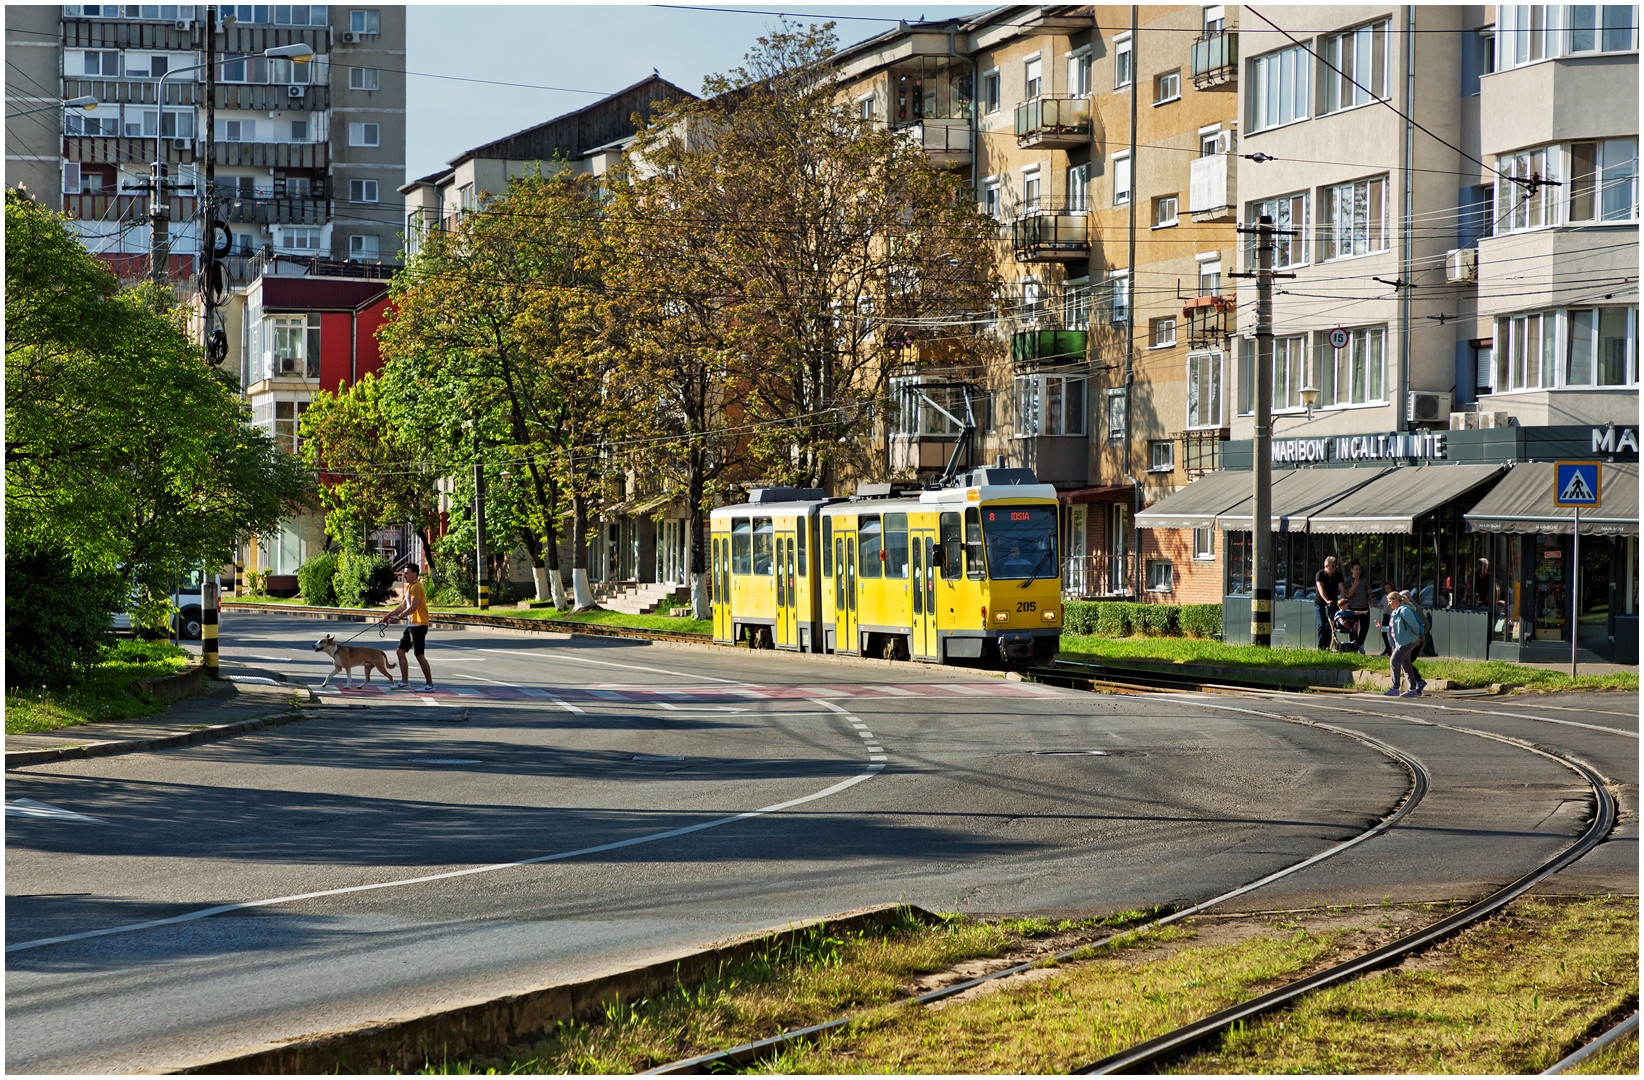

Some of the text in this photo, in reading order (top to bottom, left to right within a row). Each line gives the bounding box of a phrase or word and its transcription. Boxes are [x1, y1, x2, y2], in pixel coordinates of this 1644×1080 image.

[1334, 333, 1344, 343] 15
[1592, 428, 1639, 453] MA
[989, 511, 1030, 521] 8 IOSIA
[1016, 601, 1037, 613] 205
